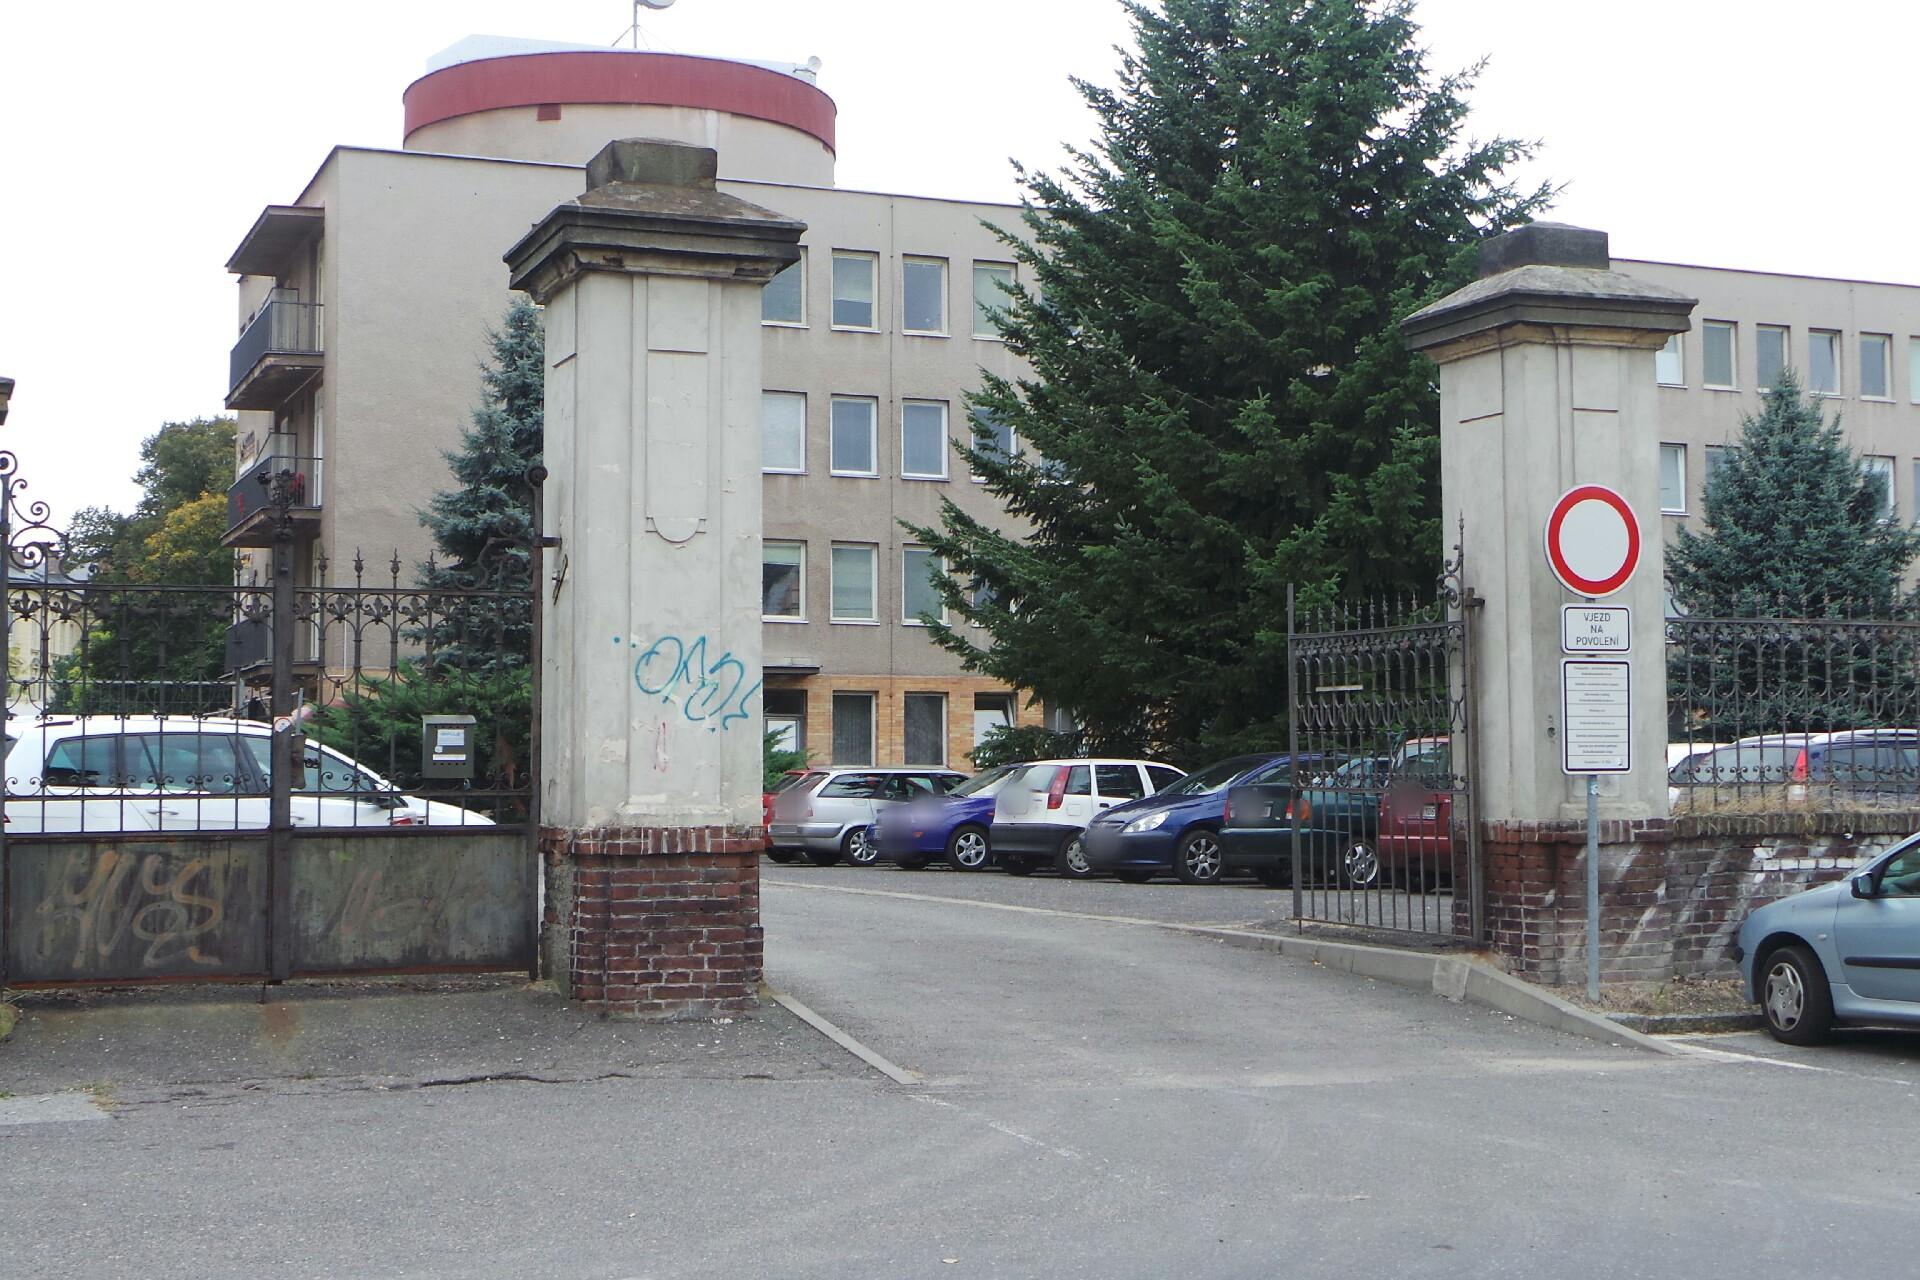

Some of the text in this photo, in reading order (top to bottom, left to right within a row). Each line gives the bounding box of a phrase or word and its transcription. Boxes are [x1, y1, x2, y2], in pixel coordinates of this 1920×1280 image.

[1583, 612, 1611, 622] VJEZD
[1590, 624, 1604, 634] NA
[1576, 634, 1619, 646] POVOLENÍ
